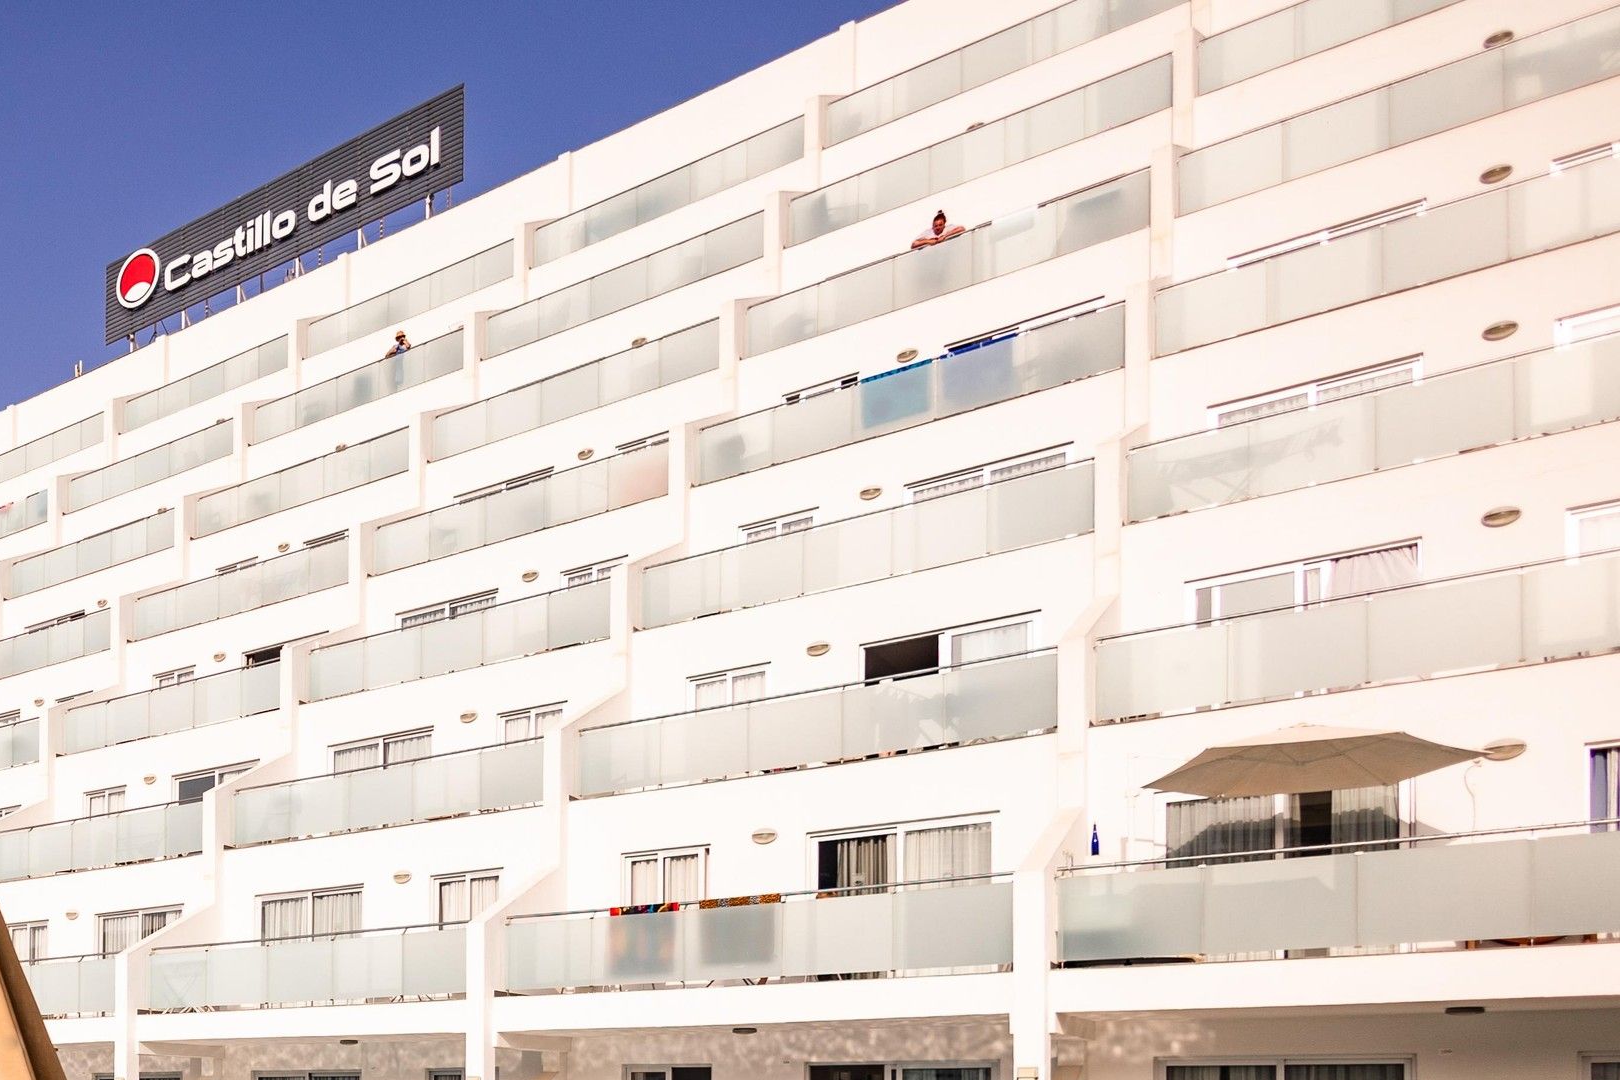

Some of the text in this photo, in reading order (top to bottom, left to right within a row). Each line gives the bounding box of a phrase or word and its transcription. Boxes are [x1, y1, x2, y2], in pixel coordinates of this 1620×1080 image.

[164, 126, 442, 292] Castillo de Sol
